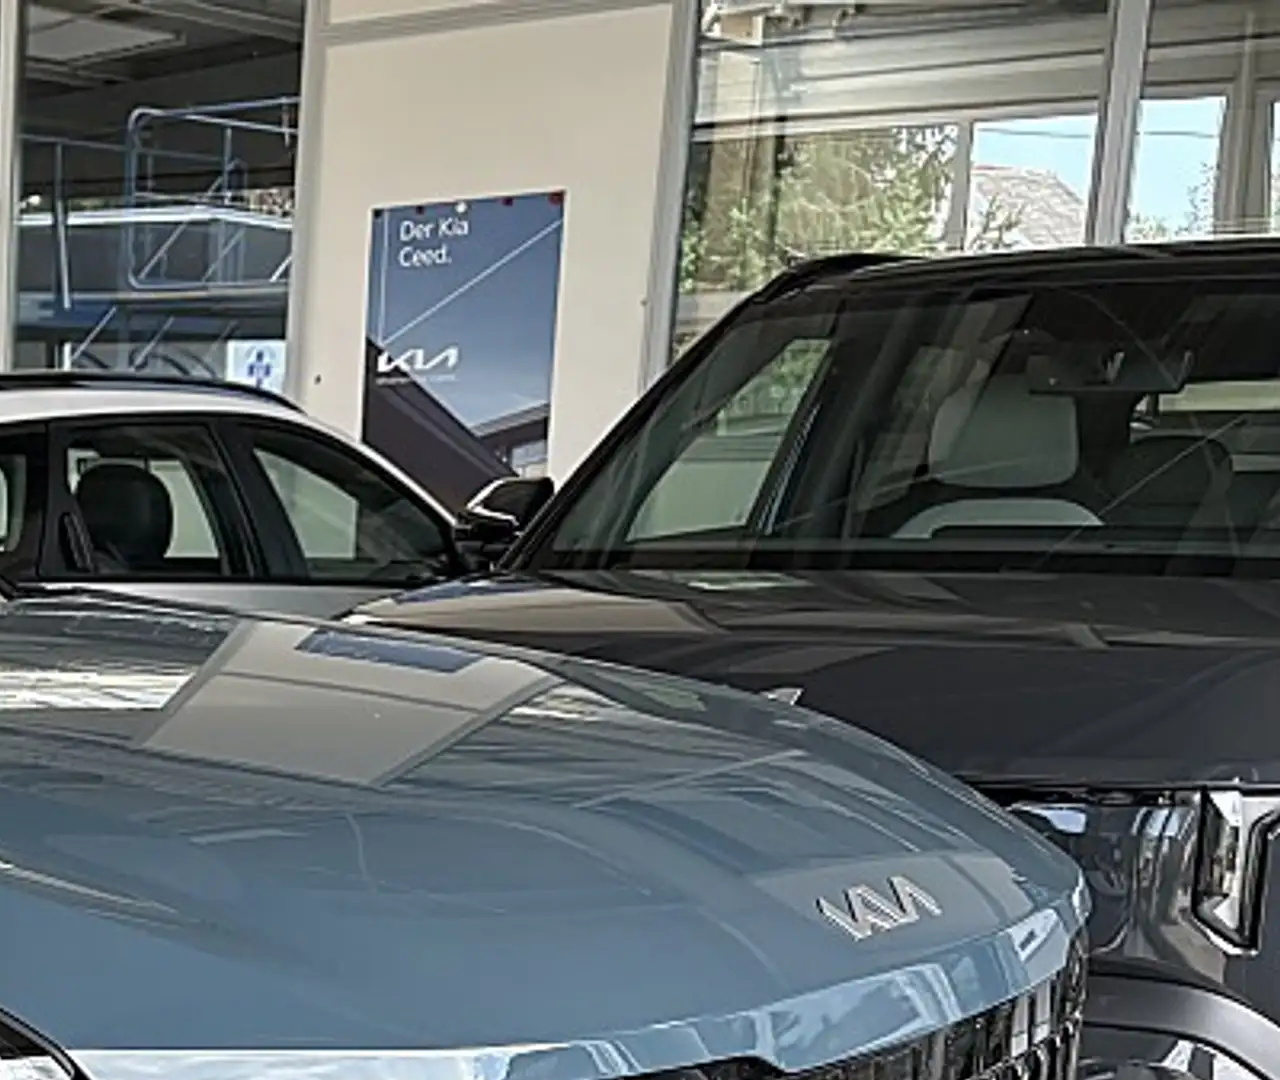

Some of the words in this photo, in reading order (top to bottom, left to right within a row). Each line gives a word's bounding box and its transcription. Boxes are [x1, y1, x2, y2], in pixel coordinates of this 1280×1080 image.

[400, 220, 436, 241] Der
[438, 217, 469, 236] Kia
[398, 243, 453, 267] Ceed.
[376, 346, 459, 373] KIA
[813, 874, 943, 941] KIA
